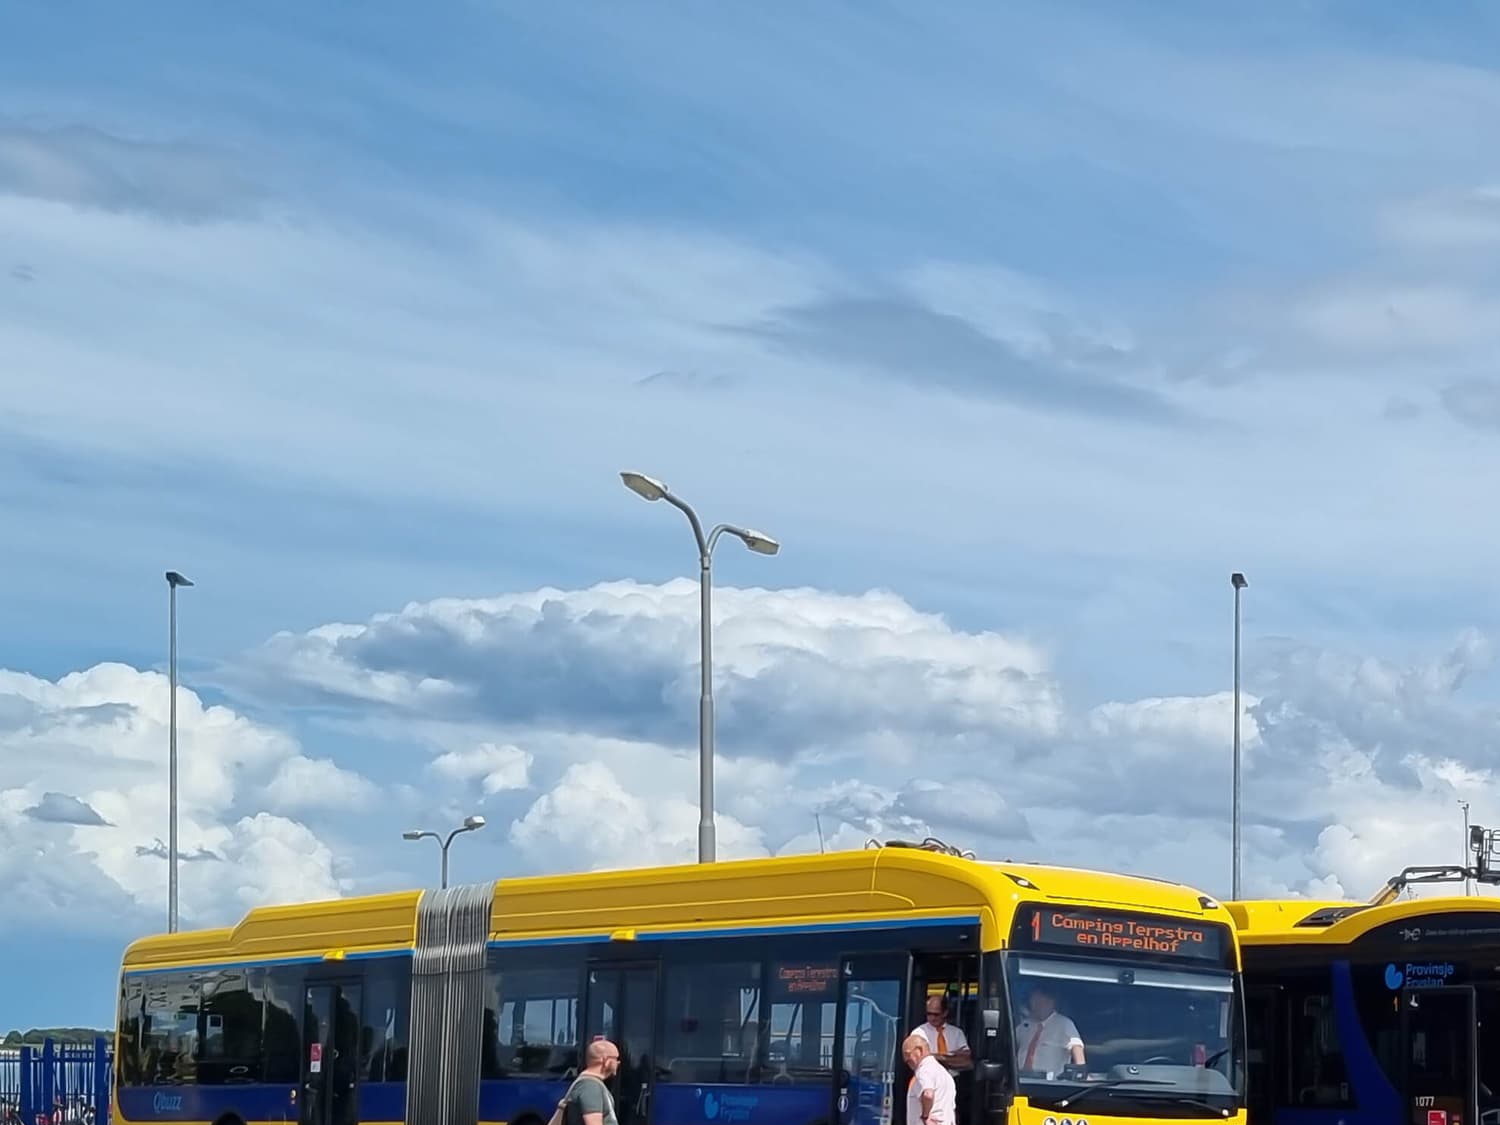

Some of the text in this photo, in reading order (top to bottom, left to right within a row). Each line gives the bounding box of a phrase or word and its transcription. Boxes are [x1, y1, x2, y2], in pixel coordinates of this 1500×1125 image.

[1032, 911, 1041, 941] 1
[1052, 913, 1203, 942] Camping Terpstra
[1076, 932, 1179, 952] en Appelhof
[1406, 962, 1455, 979] Provinsje
[153, 1091, 182, 1114] Qbuzz
[1415, 1096, 1435, 1107] 1077
